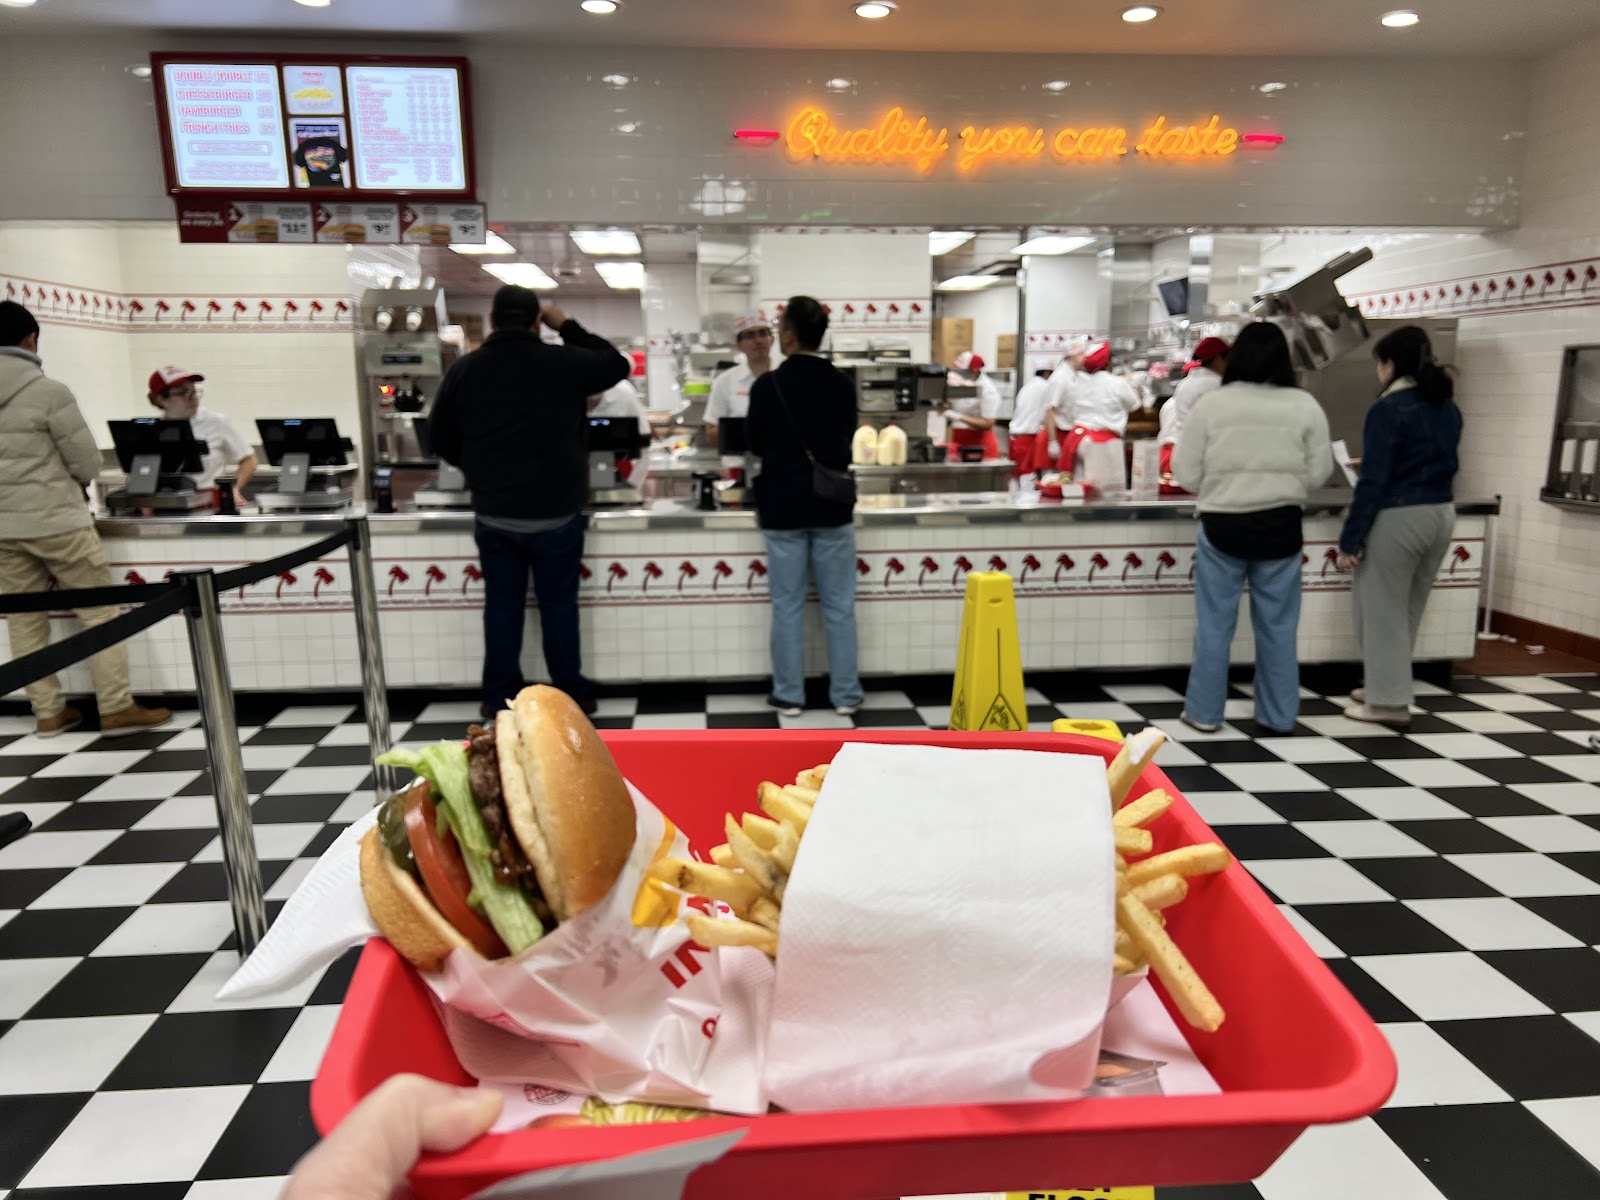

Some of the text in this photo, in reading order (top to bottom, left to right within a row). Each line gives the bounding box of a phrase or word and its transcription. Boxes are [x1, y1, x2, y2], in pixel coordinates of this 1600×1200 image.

[177, 90, 252, 100] CHEESEBURGER
[179, 106, 241, 116] HAMBURGER
[181, 122, 218, 133] FRENCH
[221, 123, 250, 133] FRIES
[785, 105, 1239, 172] Quality you can taste
